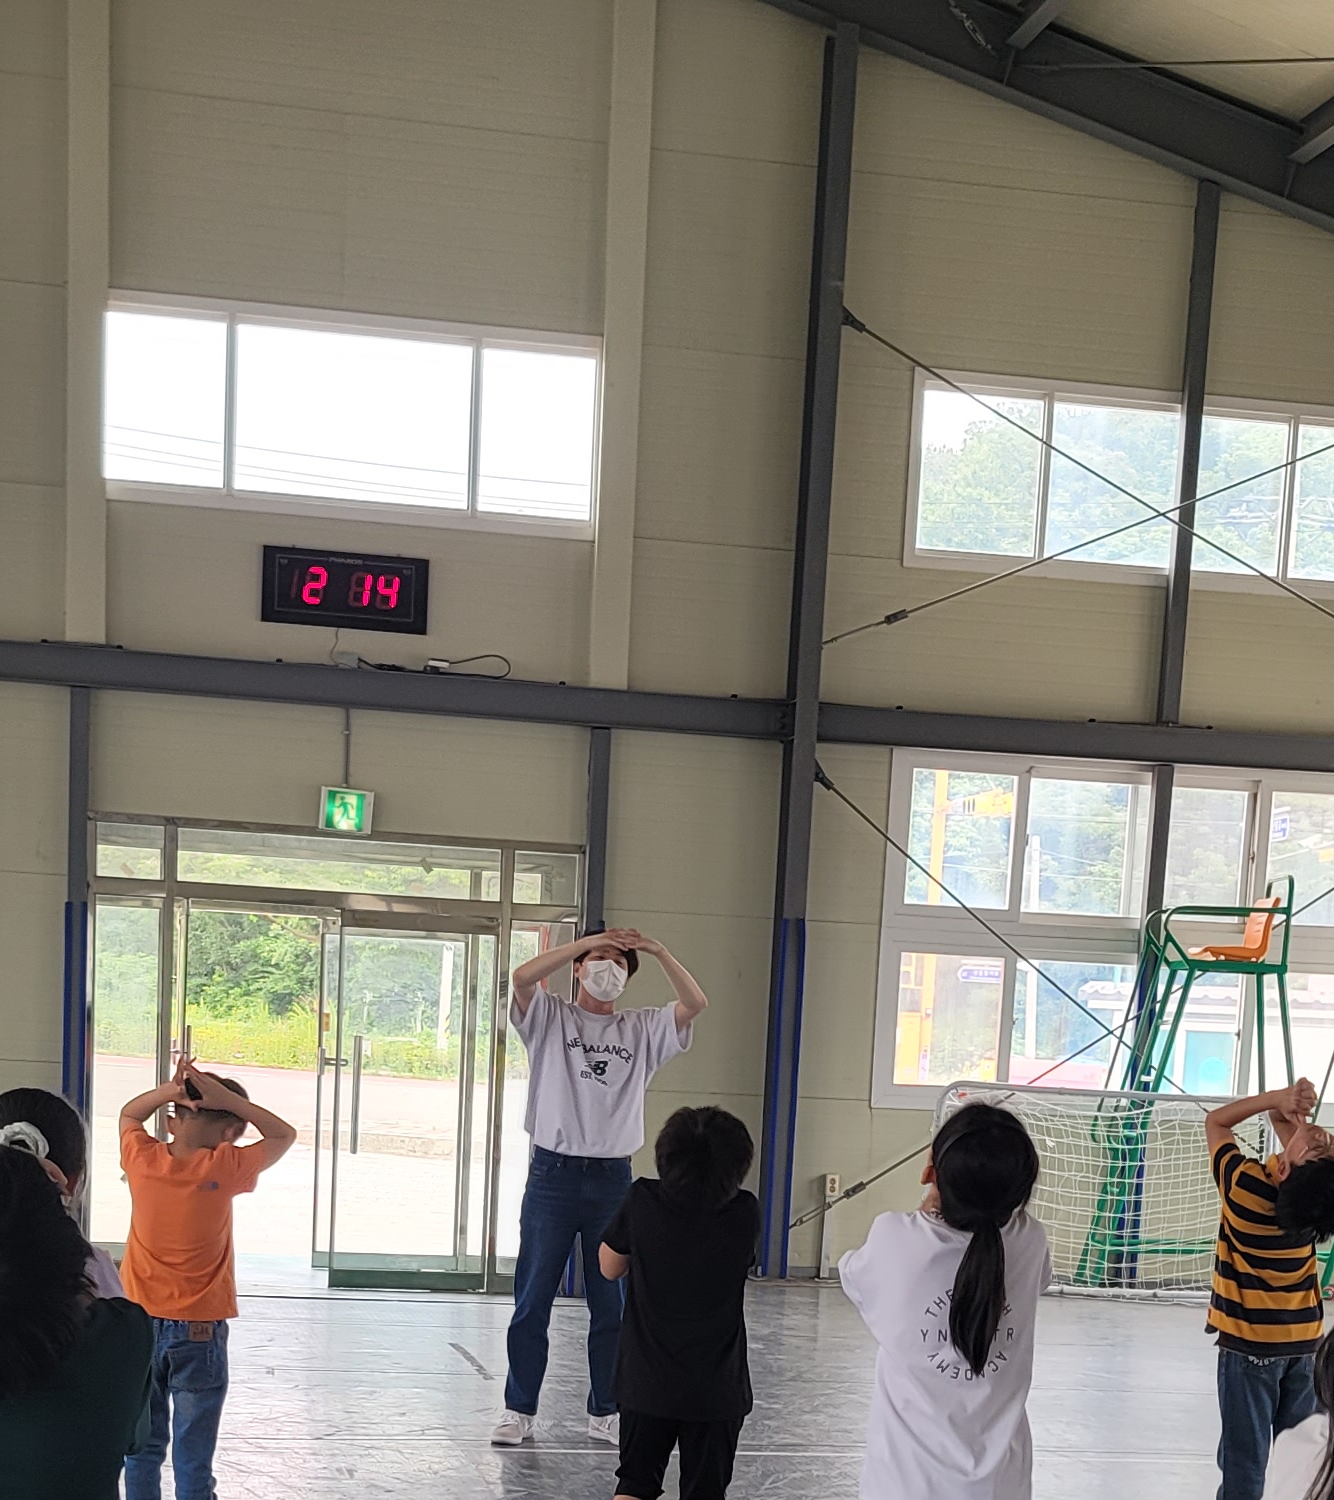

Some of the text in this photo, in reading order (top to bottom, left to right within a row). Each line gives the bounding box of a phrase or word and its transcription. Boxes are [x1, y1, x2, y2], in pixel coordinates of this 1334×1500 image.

[302, 566, 401, 608] 2 14
[581, 1044, 634, 1065] BALANCE
